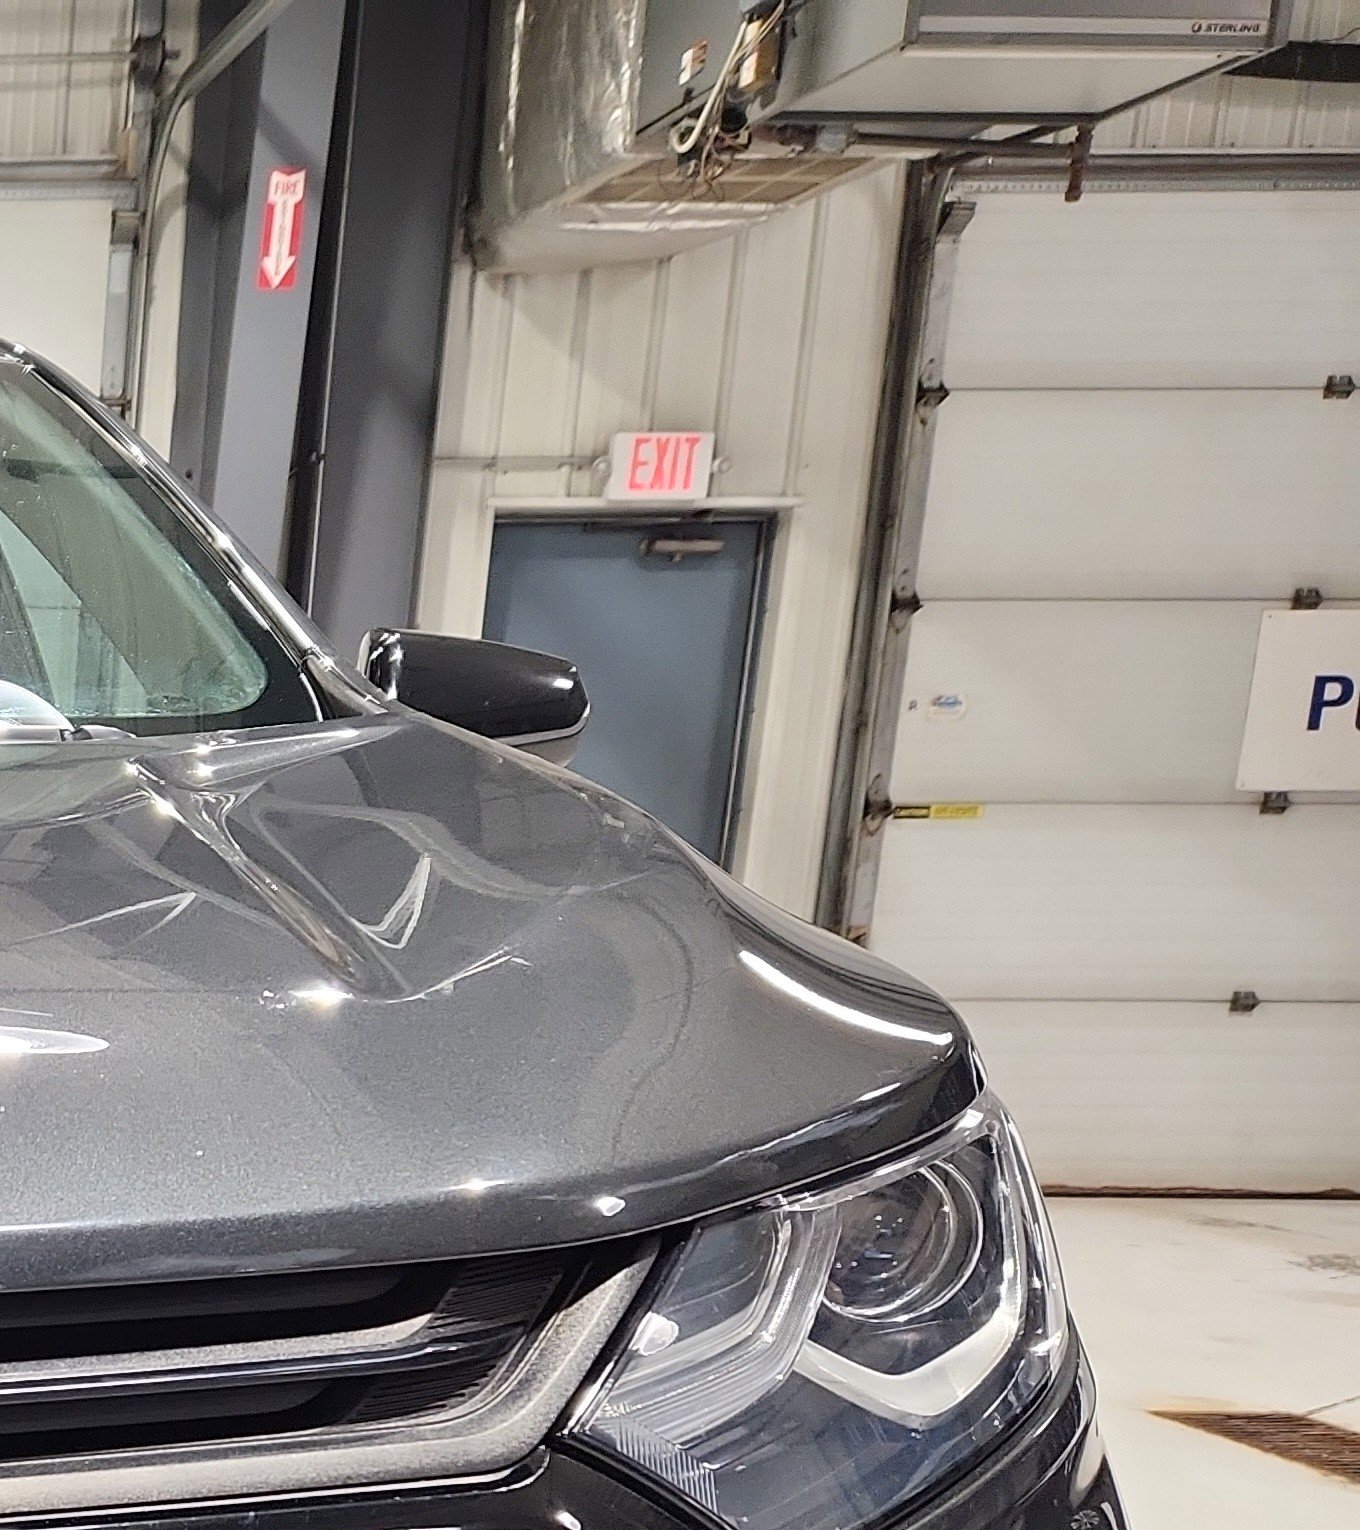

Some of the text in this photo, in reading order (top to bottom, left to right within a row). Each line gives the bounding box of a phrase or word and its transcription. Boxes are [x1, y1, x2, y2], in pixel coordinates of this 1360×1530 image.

[1205, 23, 1261, 33] STERLING
[628, 436, 701, 490] EXIT
[1306, 675, 1360, 731] P
